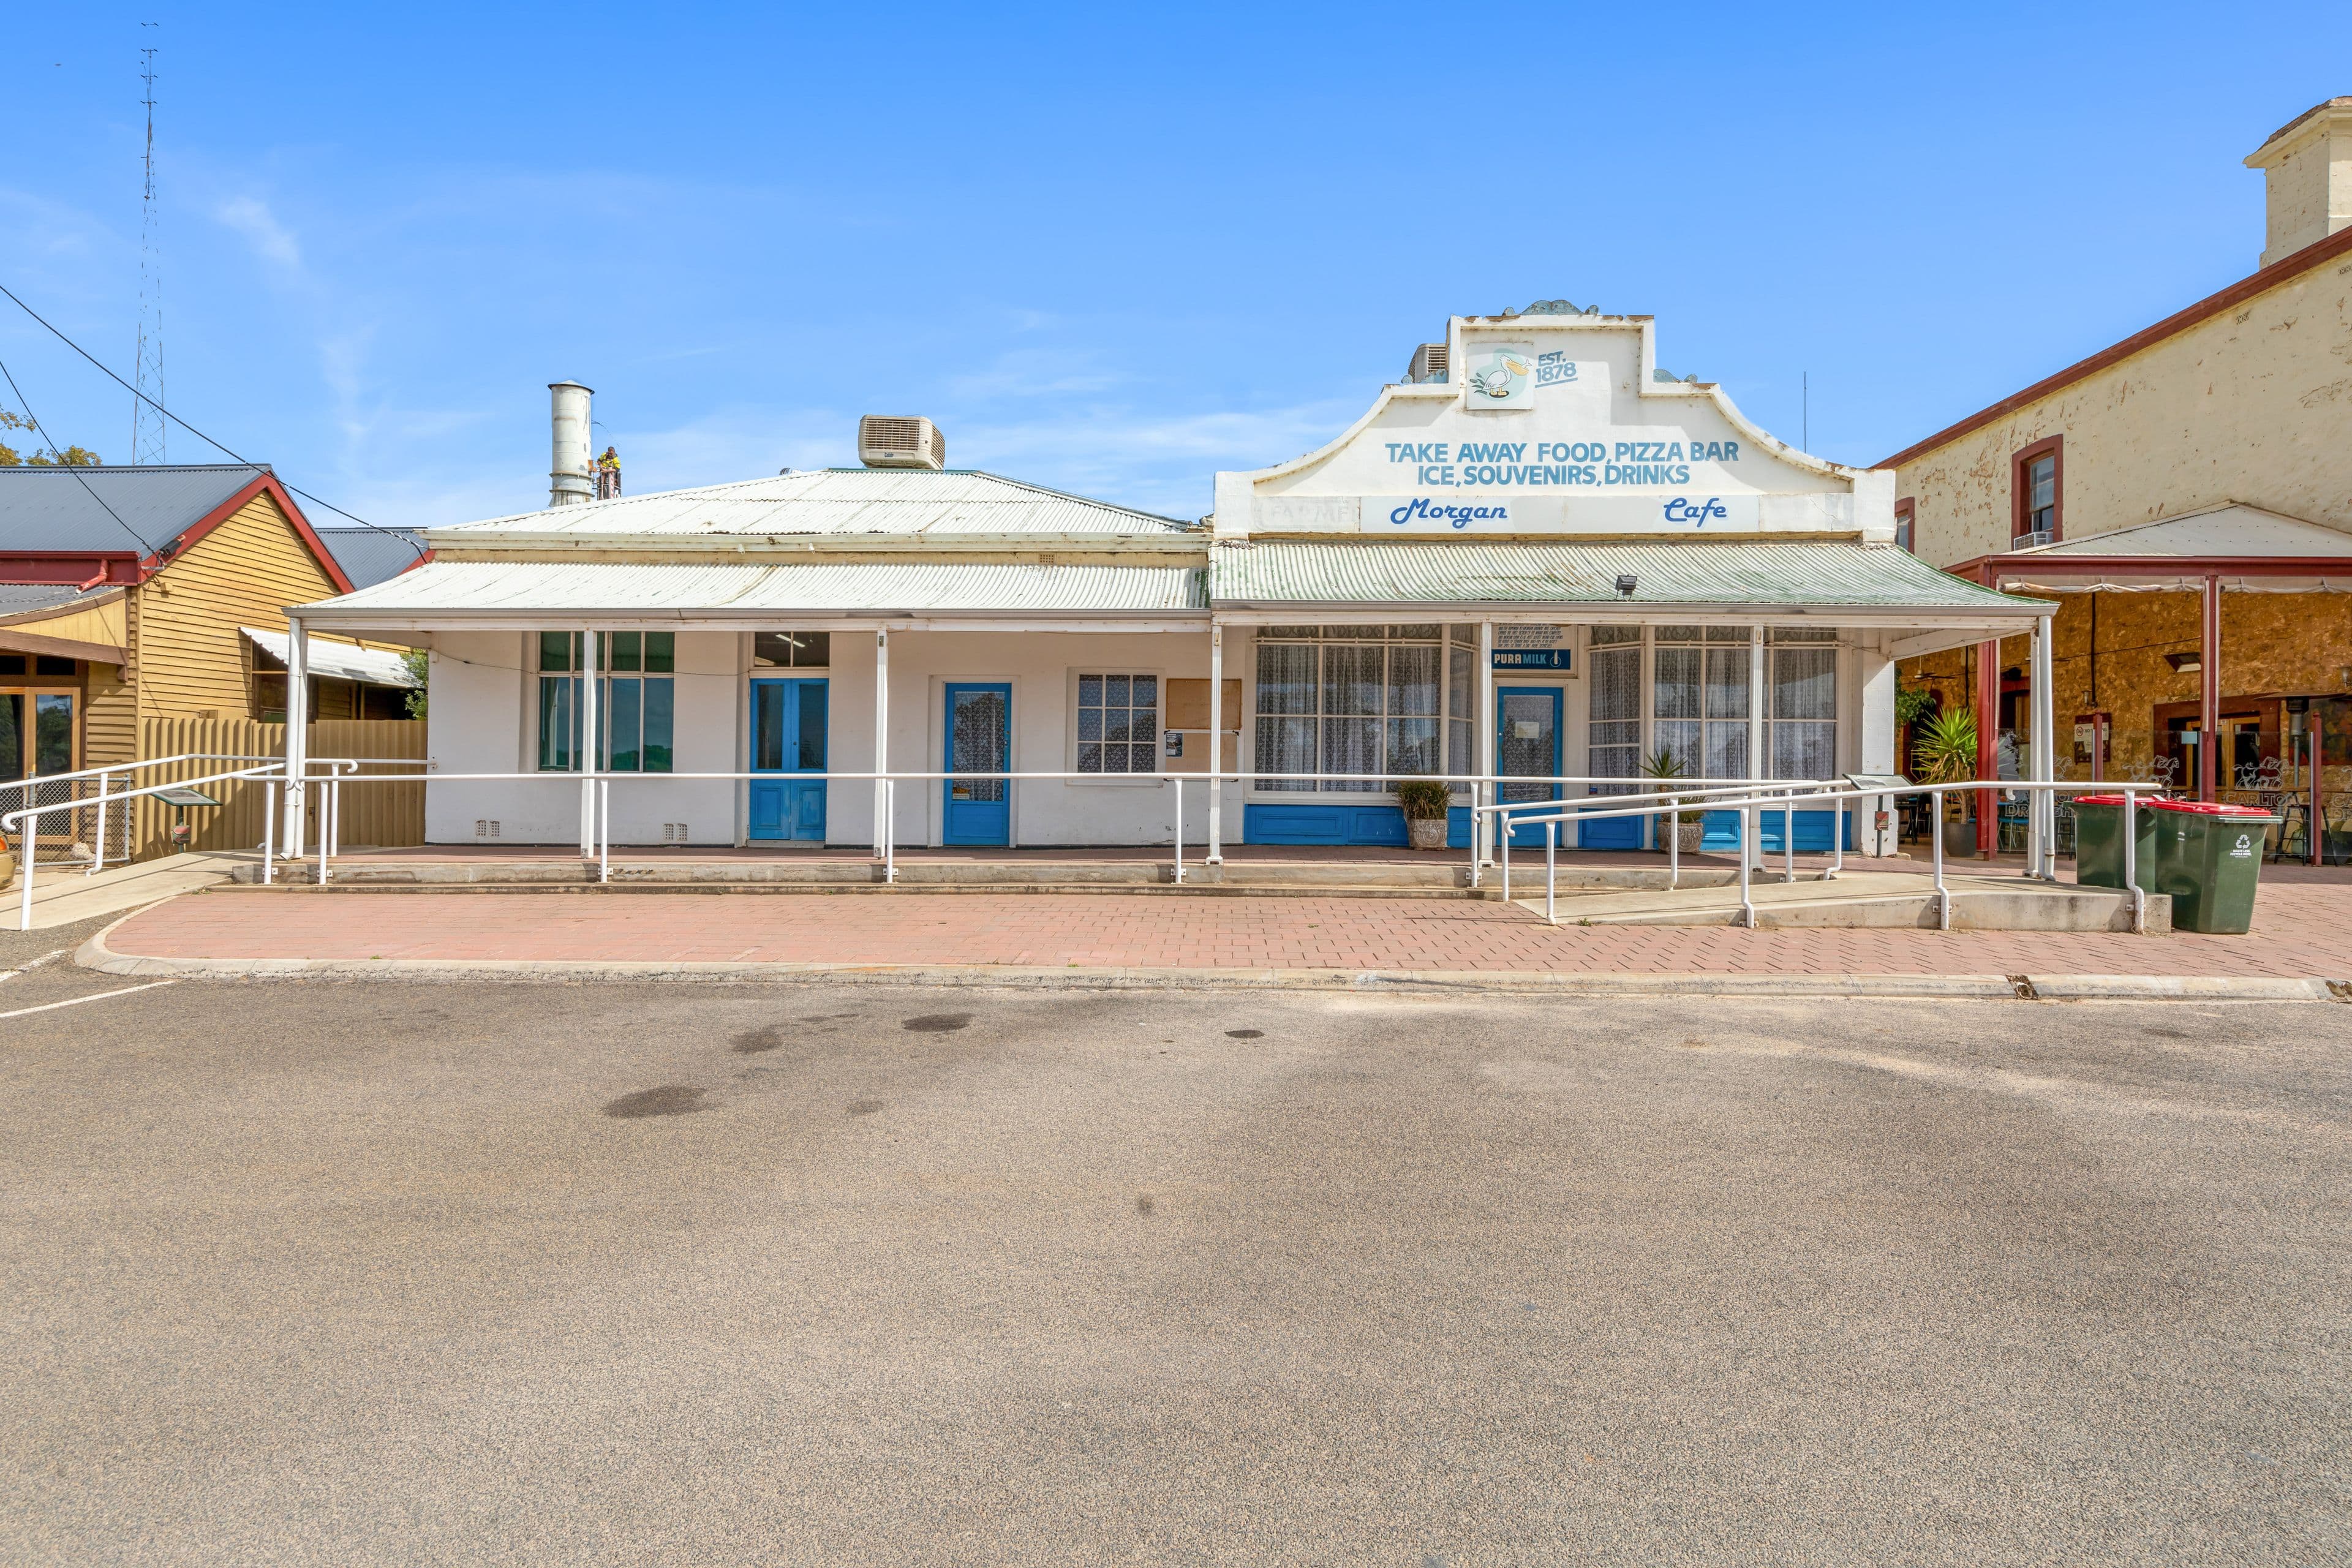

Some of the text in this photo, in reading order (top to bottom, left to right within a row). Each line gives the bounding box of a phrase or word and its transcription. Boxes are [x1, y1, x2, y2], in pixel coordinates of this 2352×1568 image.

[1538, 351, 1566, 367] EST.
[1536, 362, 1577, 383] 1878
[1385, 442, 1449, 463] TAKE
[1456, 442, 1528, 463] AWAY
[1615, 442, 1684, 462] PIZZA
[1690, 442, 1739, 461] BAR
[1604, 465, 1691, 485] DRINKS
[1390, 497, 1727, 529] Morgan Cafe
[1494, 654, 1547, 664] PURA MILK
